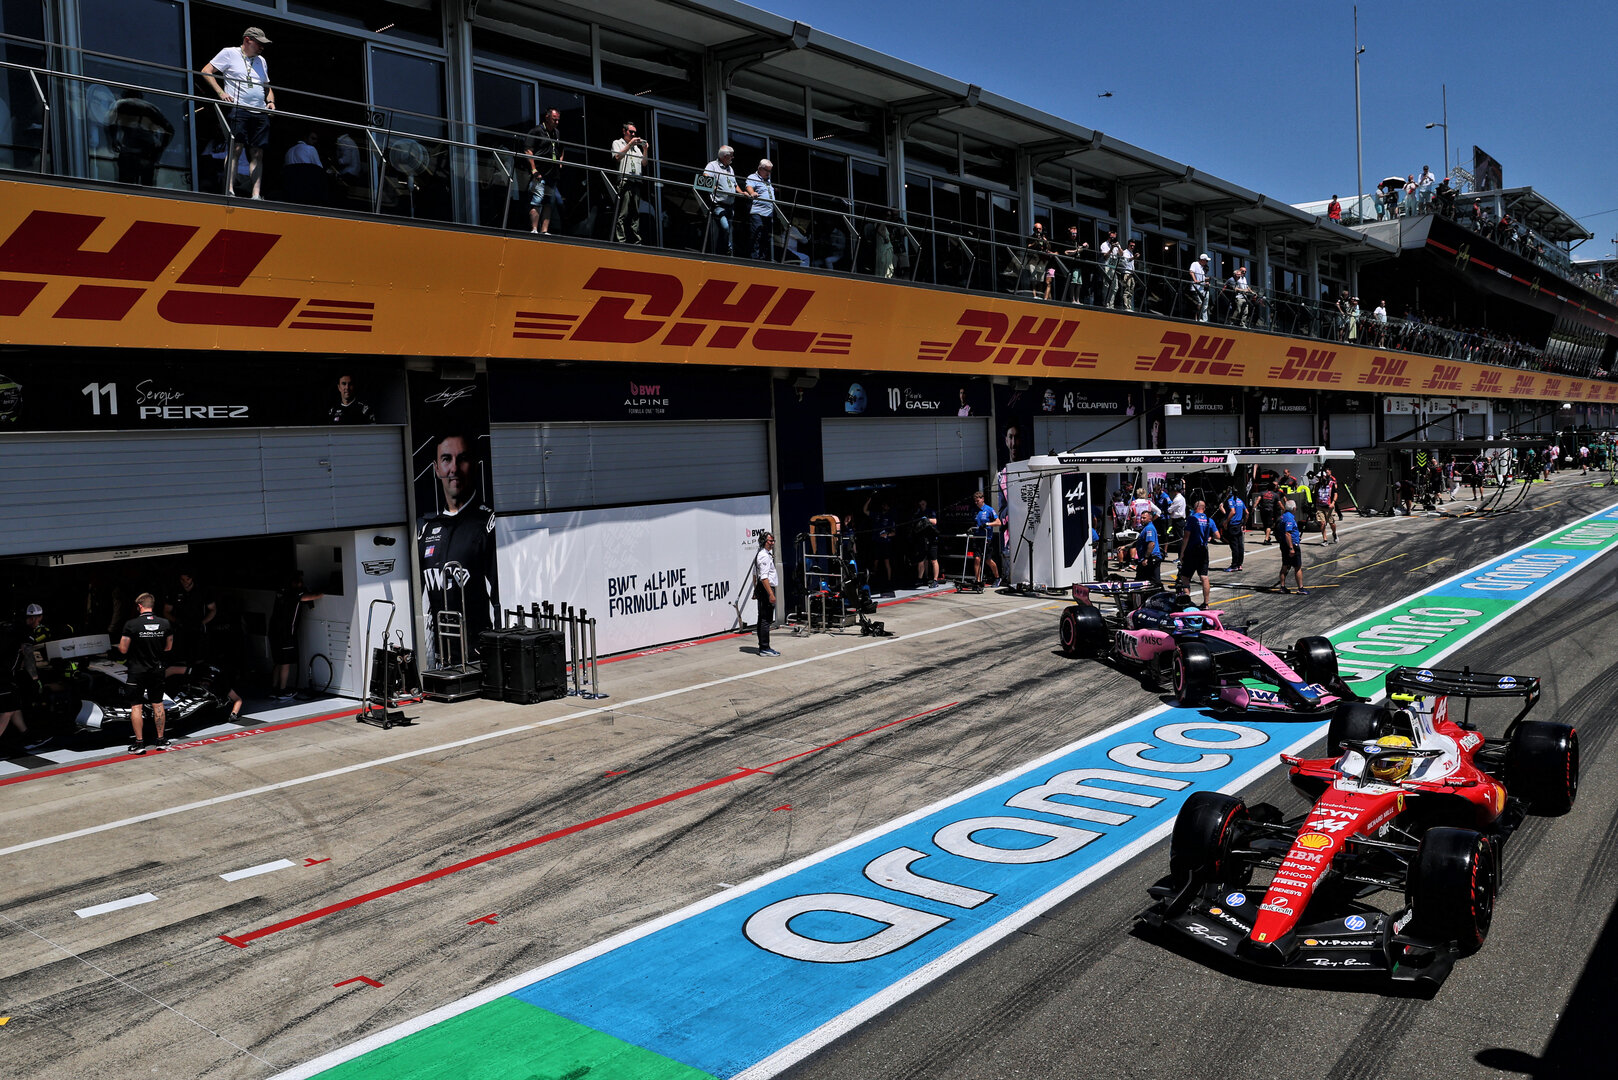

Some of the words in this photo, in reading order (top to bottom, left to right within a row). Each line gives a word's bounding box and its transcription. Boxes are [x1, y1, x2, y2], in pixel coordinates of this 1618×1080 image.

[0, 210, 301, 328] HL
[569, 267, 819, 353] DHL
[945, 309, 1080, 368] DHL
[1150, 331, 1236, 376] DHL
[1278, 346, 1337, 382] DHL
[1365, 356, 1408, 386] DHL
[1428, 364, 1461, 390] DHL
[136, 379, 184, 405] Sergio
[639, 385, 660, 395] BWT
[82, 382, 118, 415] 11
[887, 387, 901, 412] 10
[905, 401, 941, 410] GASLY
[1062, 391, 1074, 412] 43
[1185, 395, 1191, 410] 5
[1271, 398, 1278, 410] 27
[140, 405, 249, 420] PEREZ
[53, 554, 64, 564] 11
[1460, 553, 1578, 591] aramco
[608, 574, 638, 598] BWT
[643, 568, 687, 592] ALPINE
[609, 590, 669, 618] FORMULA
[672, 585, 697, 607] ONE
[701, 580, 730, 602] TEAM
[1145, 635, 1163, 646] MSC
[1435, 696, 1447, 724] 44
[1312, 807, 1360, 820] ZYN
[1318, 802, 1365, 812] Bitdefender
[1306, 818, 1350, 833] 44
[1367, 813, 1384, 831] RICHARD
[1383, 806, 1395, 819] MILLE
[742, 721, 1271, 964] aramco
[1286, 850, 1324, 864] IBM
[1278, 869, 1313, 880] WHOOP
[1272, 877, 1309, 889] PIRELLI
[1273, 887, 1303, 897] GENESYS
[1228, 894, 1244, 906] hp
[1347, 917, 1364, 930] hp
[1318, 939, 1376, 947] V-Power
[1305, 957, 1371, 967] Ray-Ban
